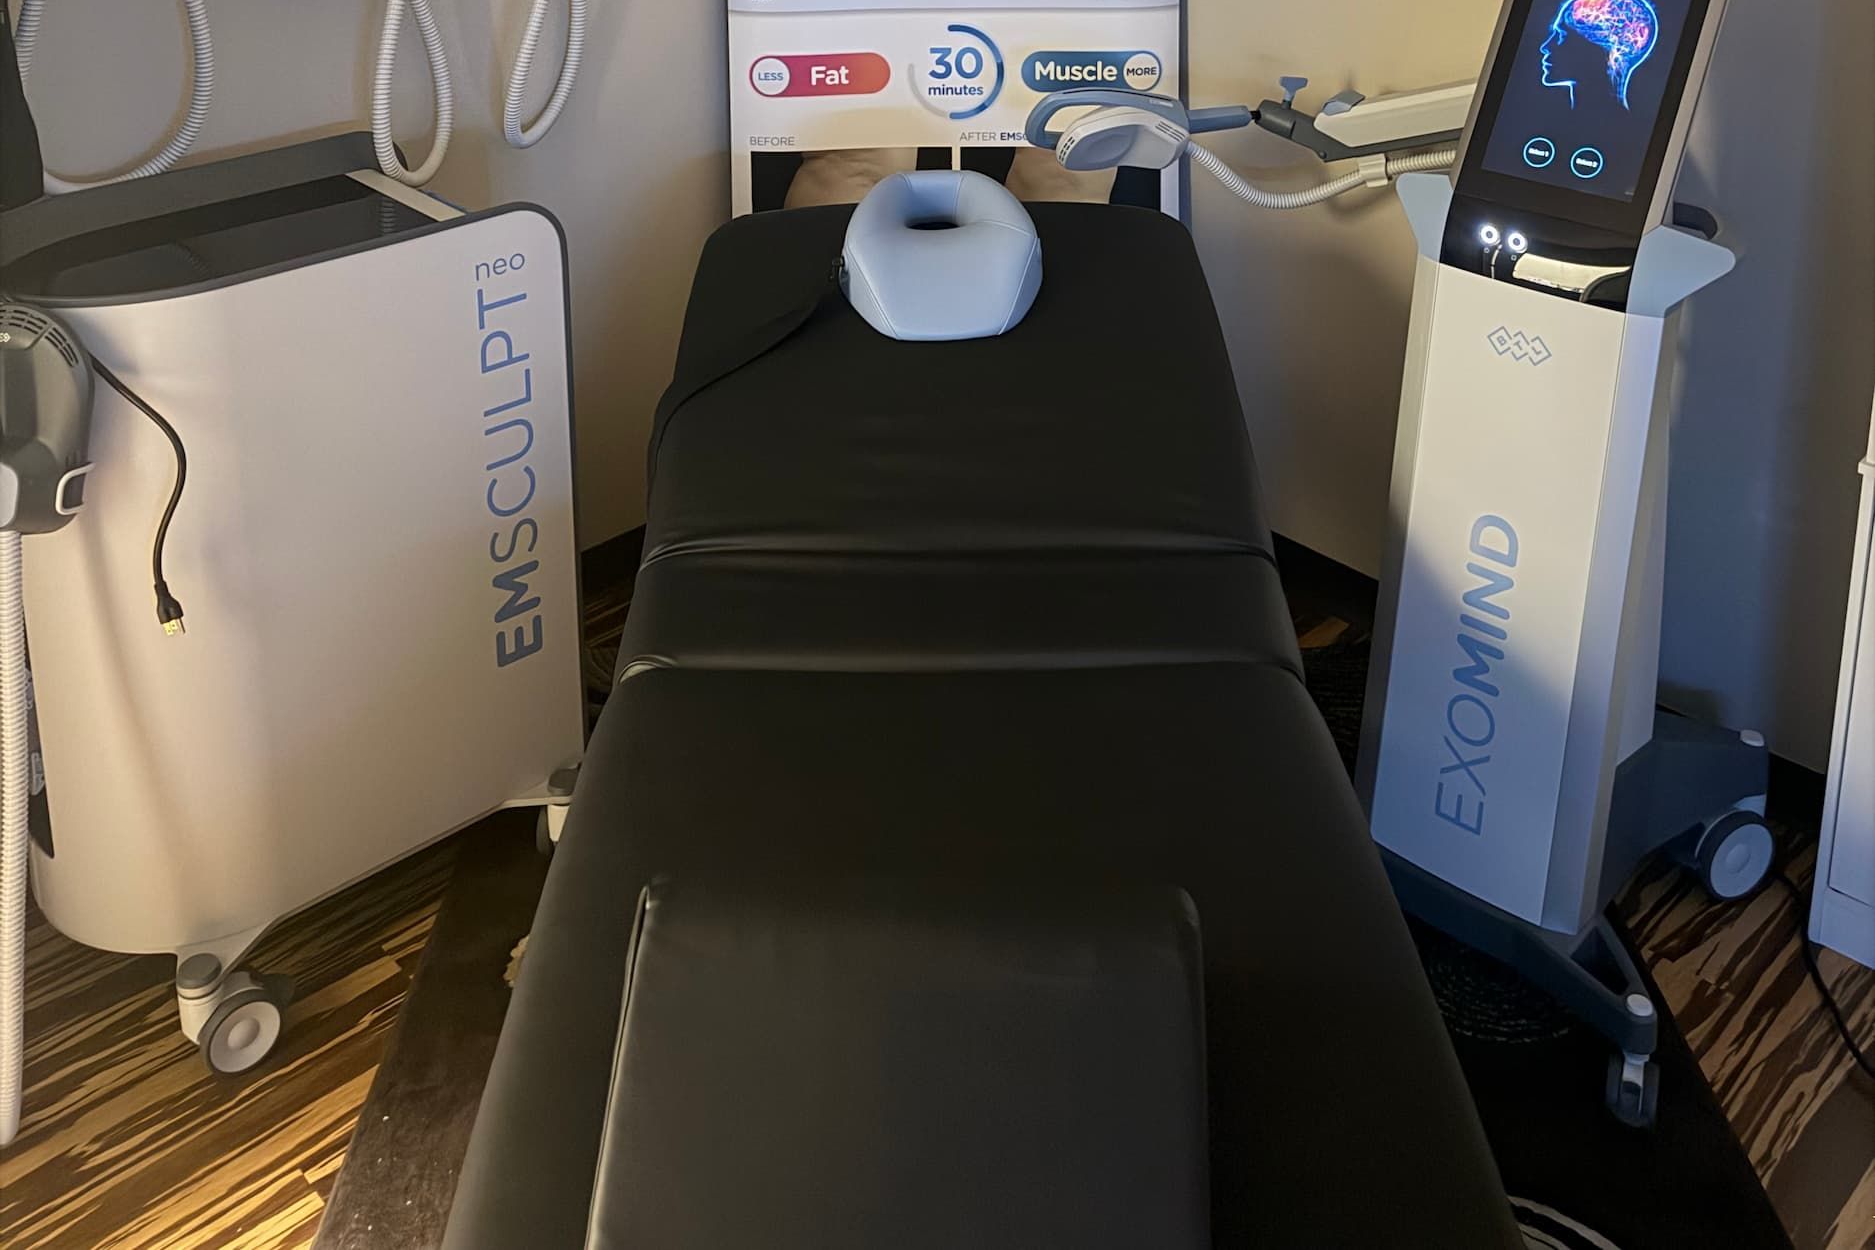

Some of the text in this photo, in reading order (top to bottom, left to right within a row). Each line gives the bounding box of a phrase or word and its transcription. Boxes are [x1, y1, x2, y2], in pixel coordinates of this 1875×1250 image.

[928, 46, 984, 80] 30
[1035, 61, 1118, 82] Muscle
[1126, 66, 1157, 76] MORE
[758, 72, 784, 81] LESS
[811, 65, 849, 86] Fat
[928, 84, 984, 96] minutes
[750, 136, 795, 146] BEFORE
[960, 132, 997, 141] AFTER
[475, 252, 526, 281] neo
[477, 288, 544, 668] EMSCULPT
[1434, 514, 1519, 836] EXOMIND
